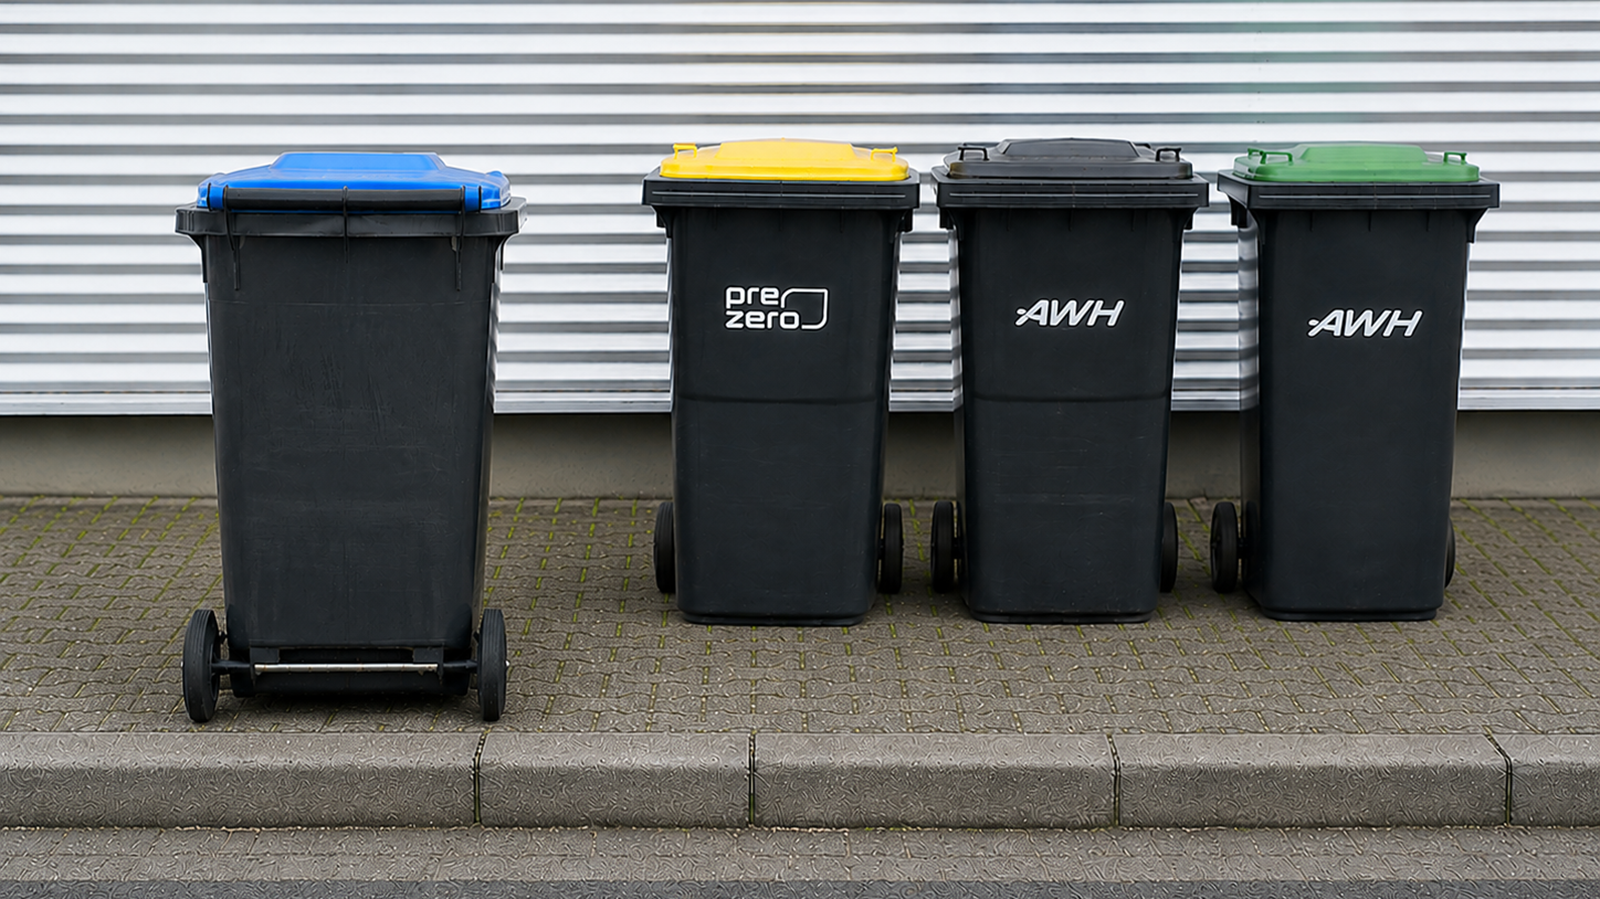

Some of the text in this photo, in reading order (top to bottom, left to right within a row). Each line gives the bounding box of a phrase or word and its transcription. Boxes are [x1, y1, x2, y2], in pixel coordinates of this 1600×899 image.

[725, 286, 780, 309] pre
[725, 310, 800, 330] zero
[1015, 299, 1125, 327] AWH
[1307, 309, 1423, 337] AWH
